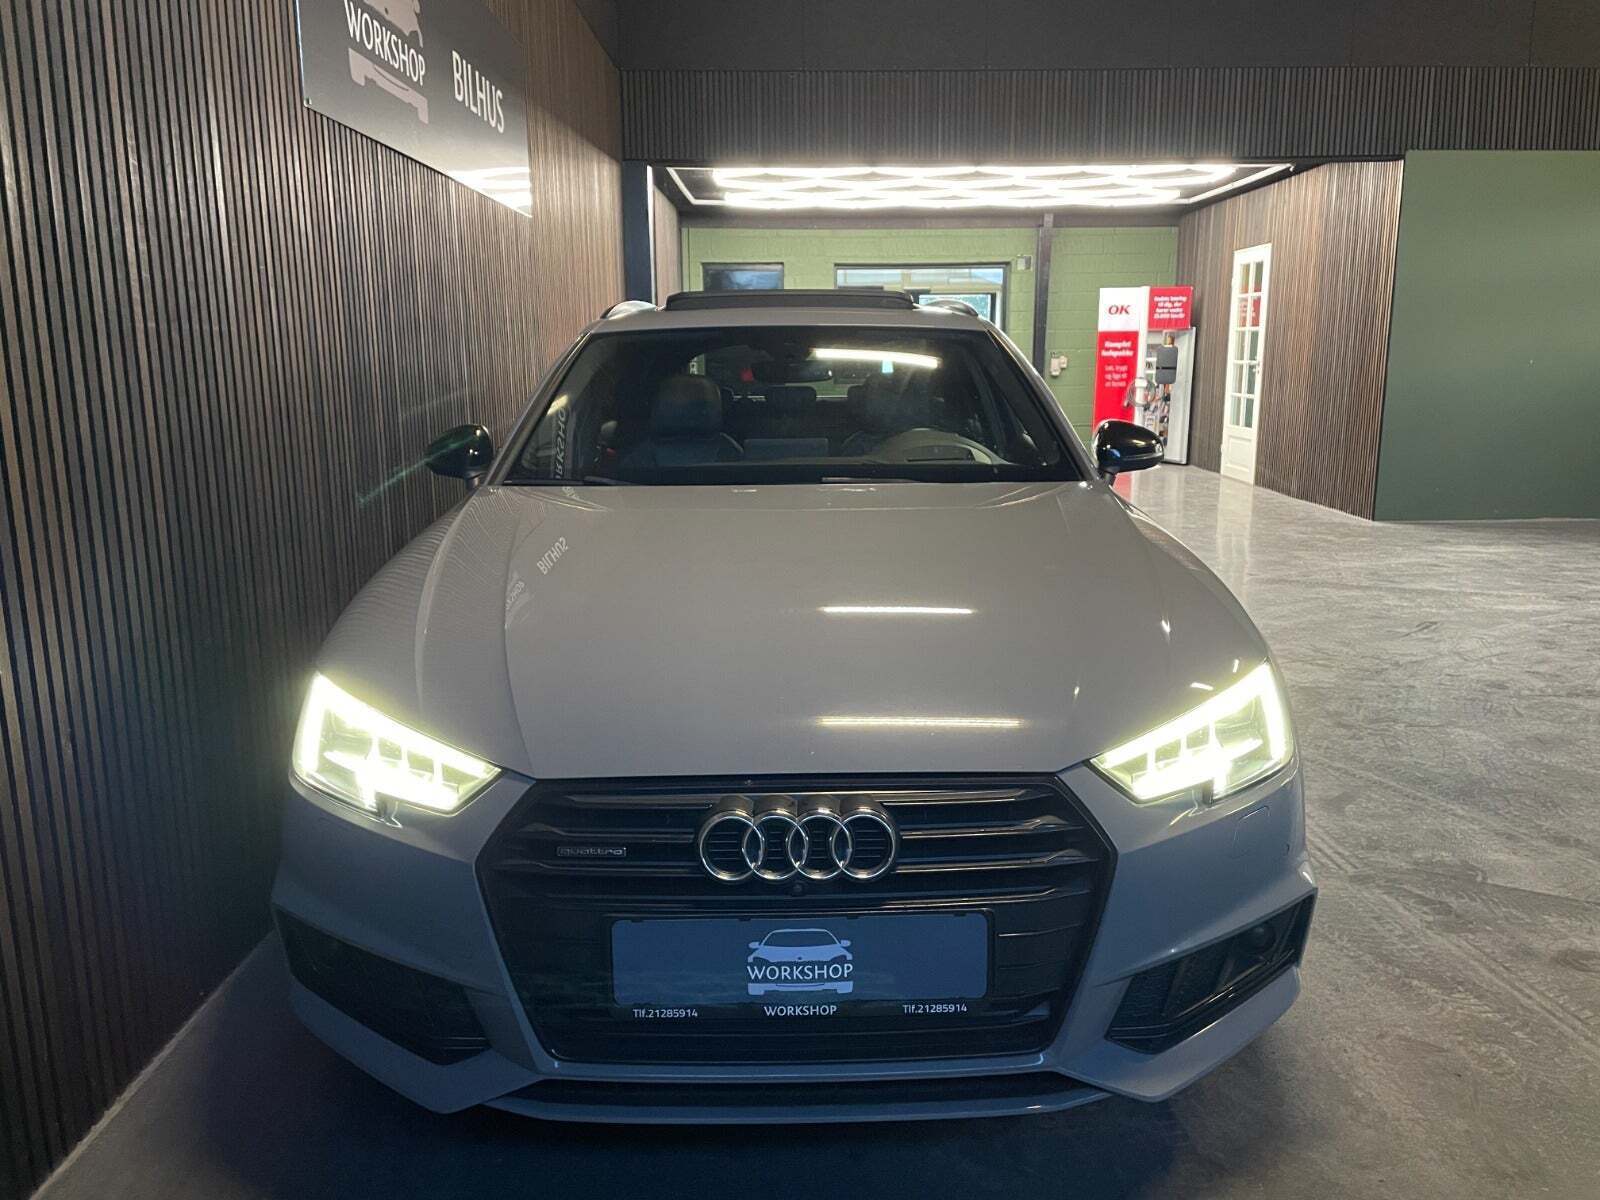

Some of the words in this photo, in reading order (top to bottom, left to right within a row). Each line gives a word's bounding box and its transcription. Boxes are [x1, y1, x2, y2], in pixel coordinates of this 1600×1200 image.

[344, 0, 426, 86] WORKSHOP
[452, 50, 504, 133] BILHUS
[1108, 304, 1131, 315] OK
[560, 847, 623, 856] quattro
[747, 962, 853, 981] WORKSHOP
[632, 1008, 698, 1018] Tlf.21285914
[763, 1004, 837, 1017] WORKSHOP
[902, 1003, 968, 1014] Tlf.21285914
